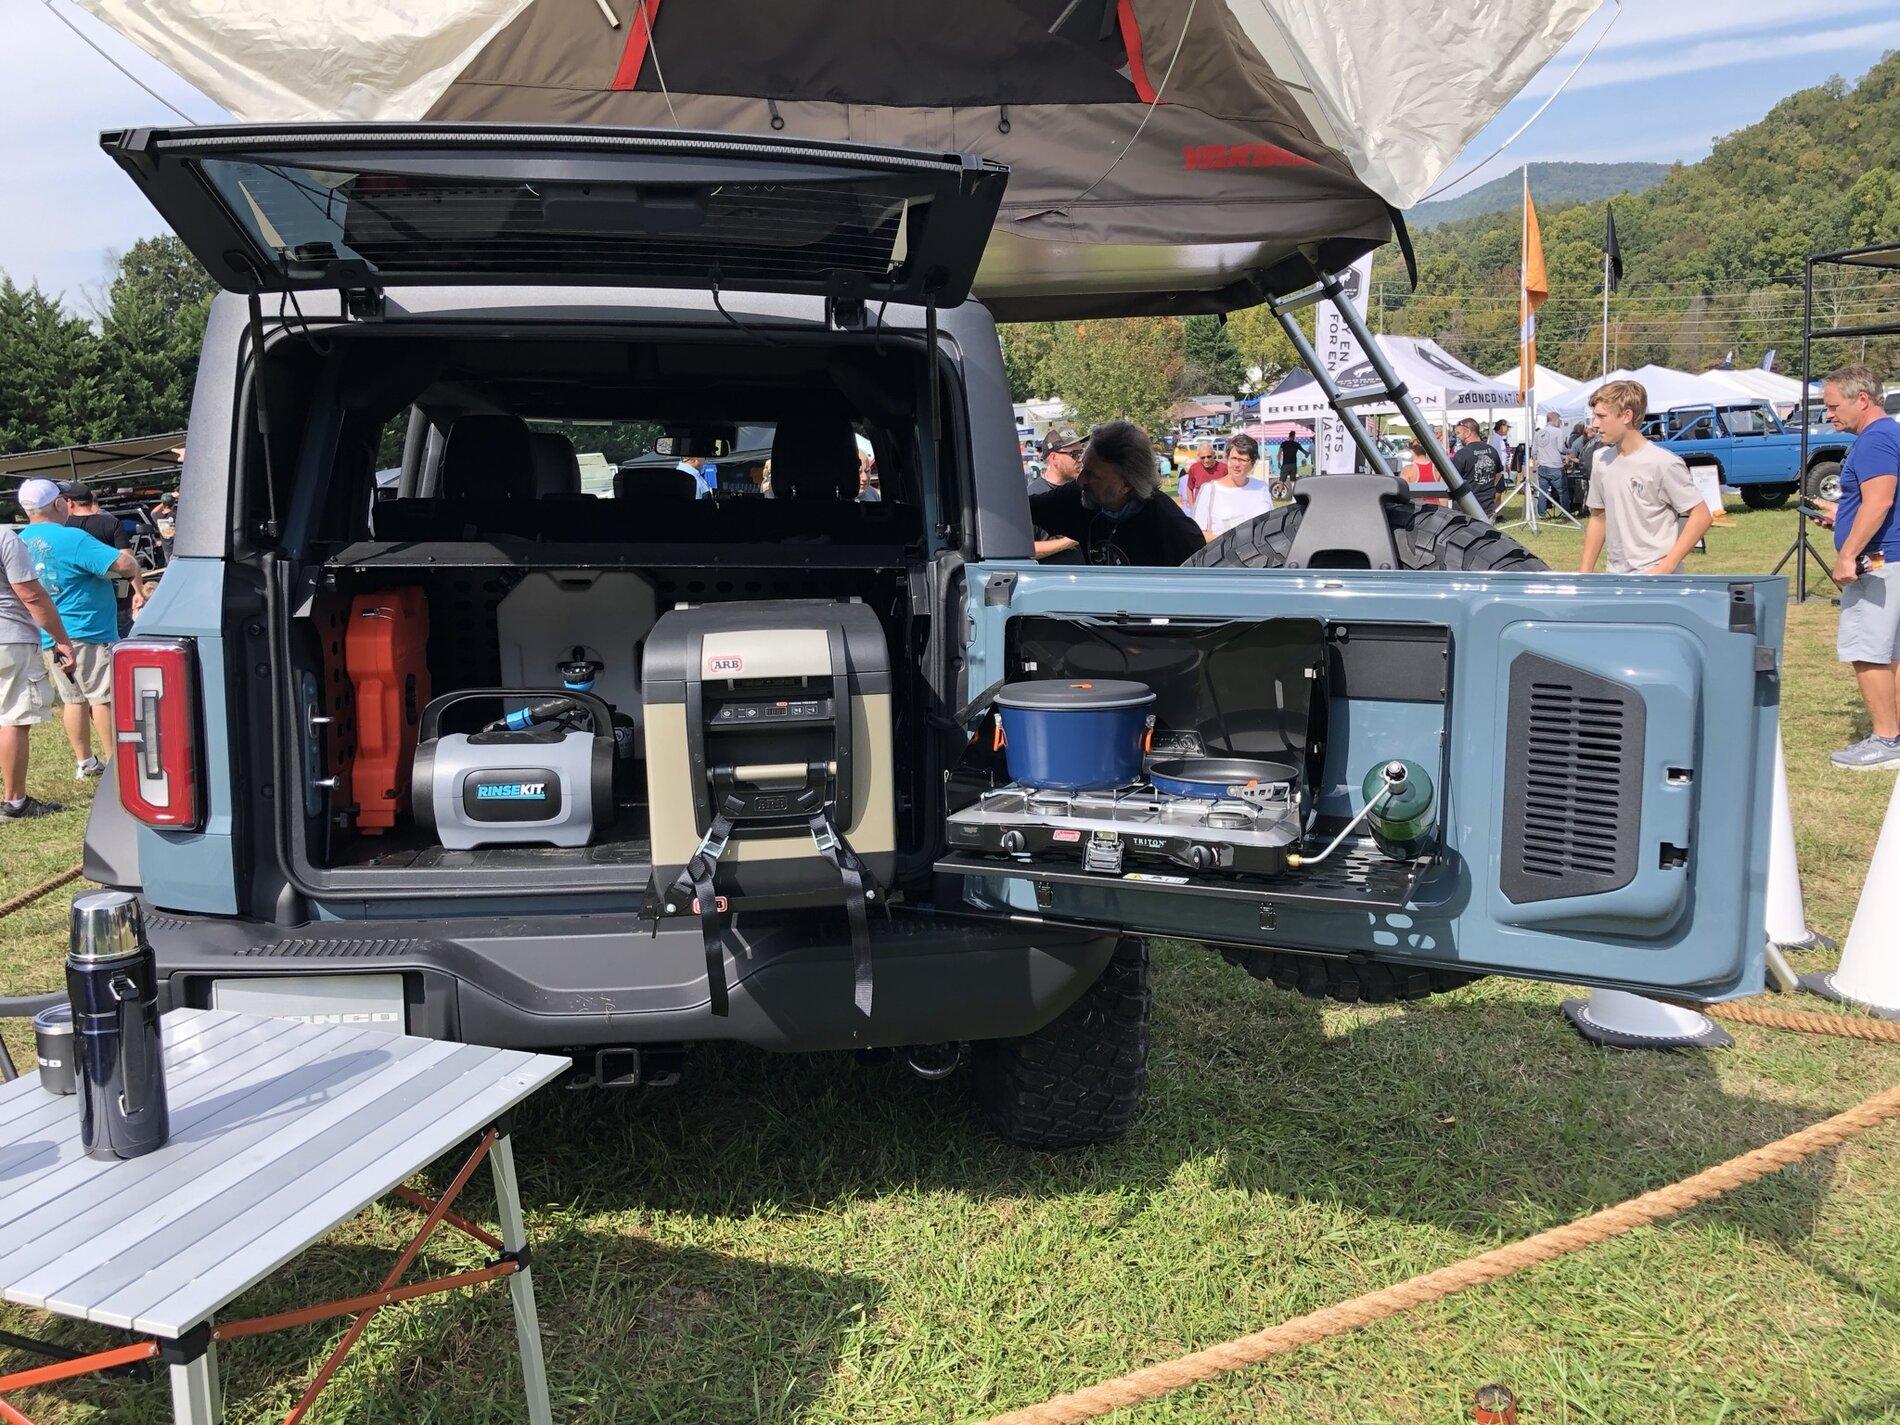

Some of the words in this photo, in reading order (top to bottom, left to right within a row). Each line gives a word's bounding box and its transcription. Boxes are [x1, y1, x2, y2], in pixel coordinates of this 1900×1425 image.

[1330, 314, 1339, 345] FOR
[1458, 393, 1497, 404] BRONCO
[714, 660, 739, 669] ARB
[1133, 837, 1165, 847] TRITON
